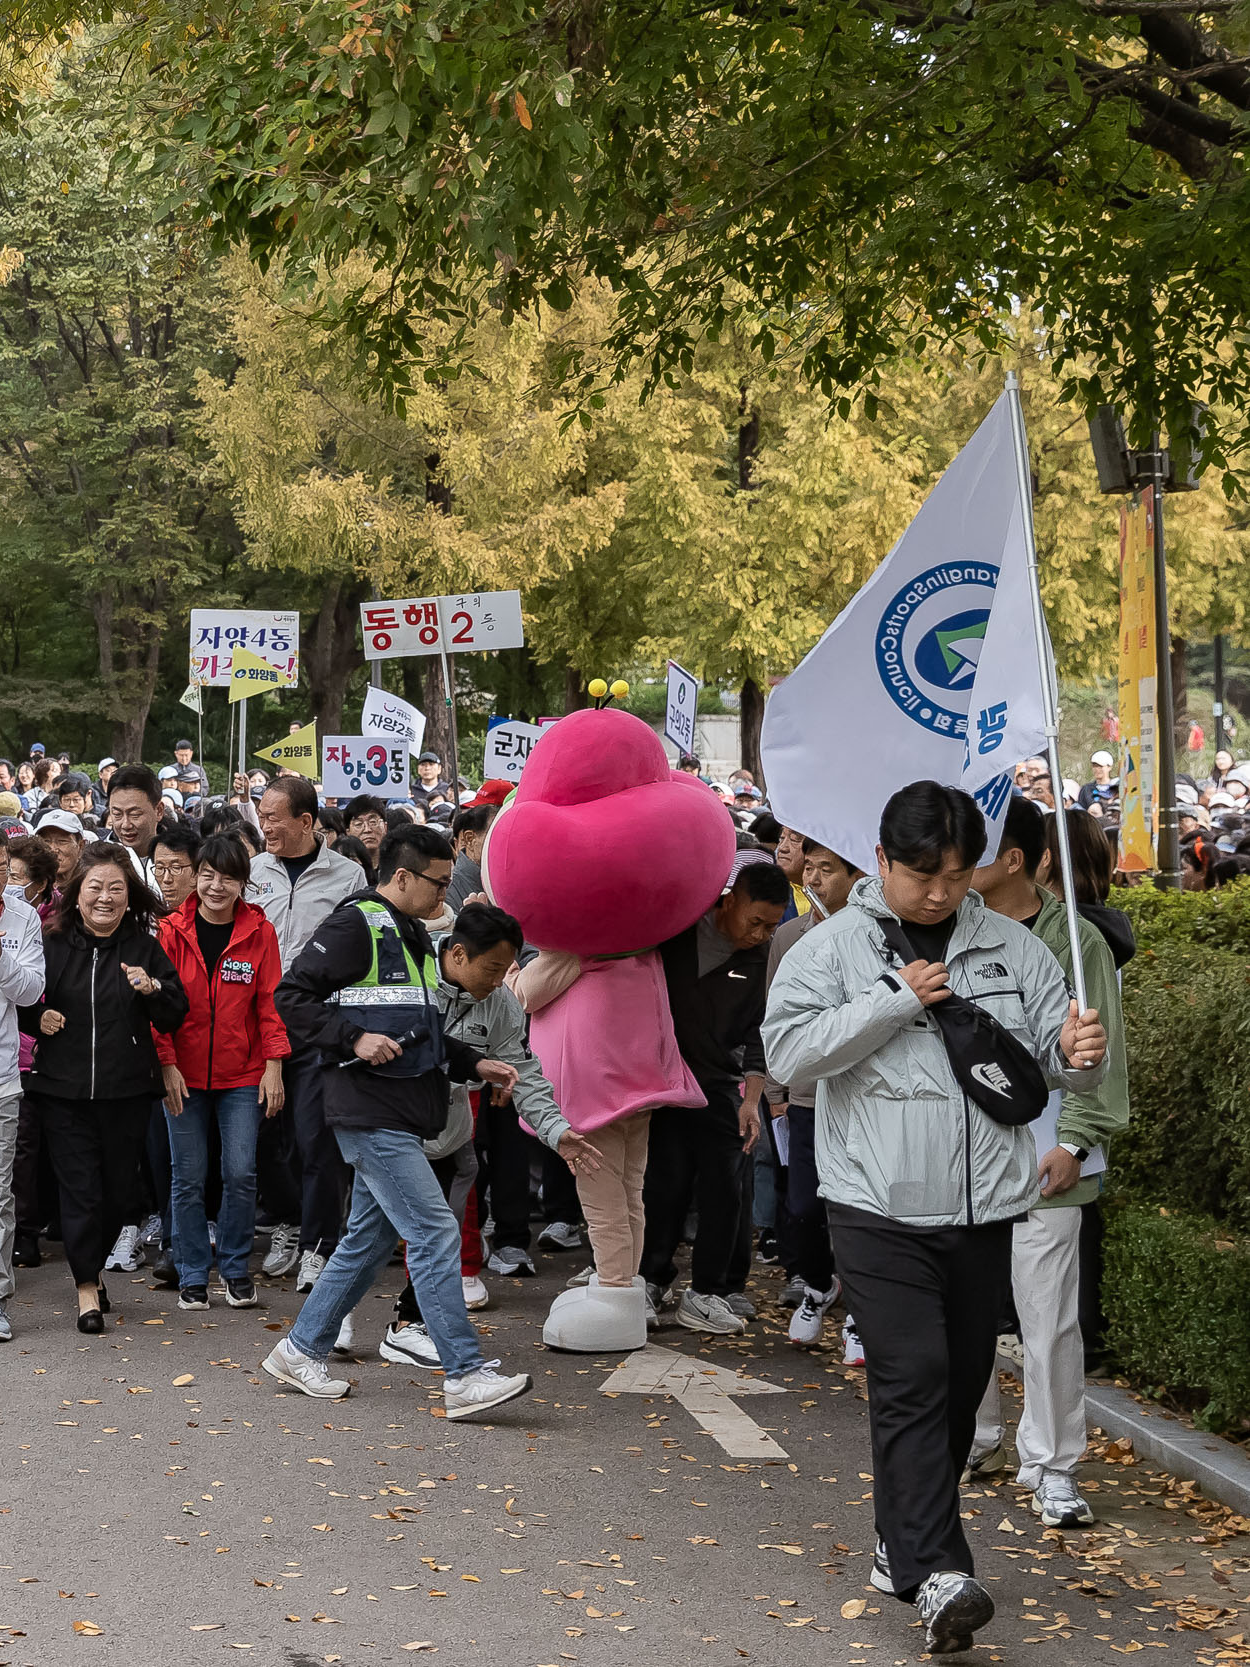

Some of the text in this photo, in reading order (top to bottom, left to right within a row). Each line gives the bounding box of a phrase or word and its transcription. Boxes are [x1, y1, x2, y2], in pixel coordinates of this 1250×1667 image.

[196, 626, 292, 651] 자양4동
[363, 602, 475, 650] 동행 2
[248, 668, 279, 683] 화양동
[368, 713, 417, 743] 자양2동
[283, 744, 313, 758] 화양동
[494, 730, 539, 760] 군자
[325, 744, 405, 791] 자양3동
[982, 1062, 1012, 1089] NIKE
